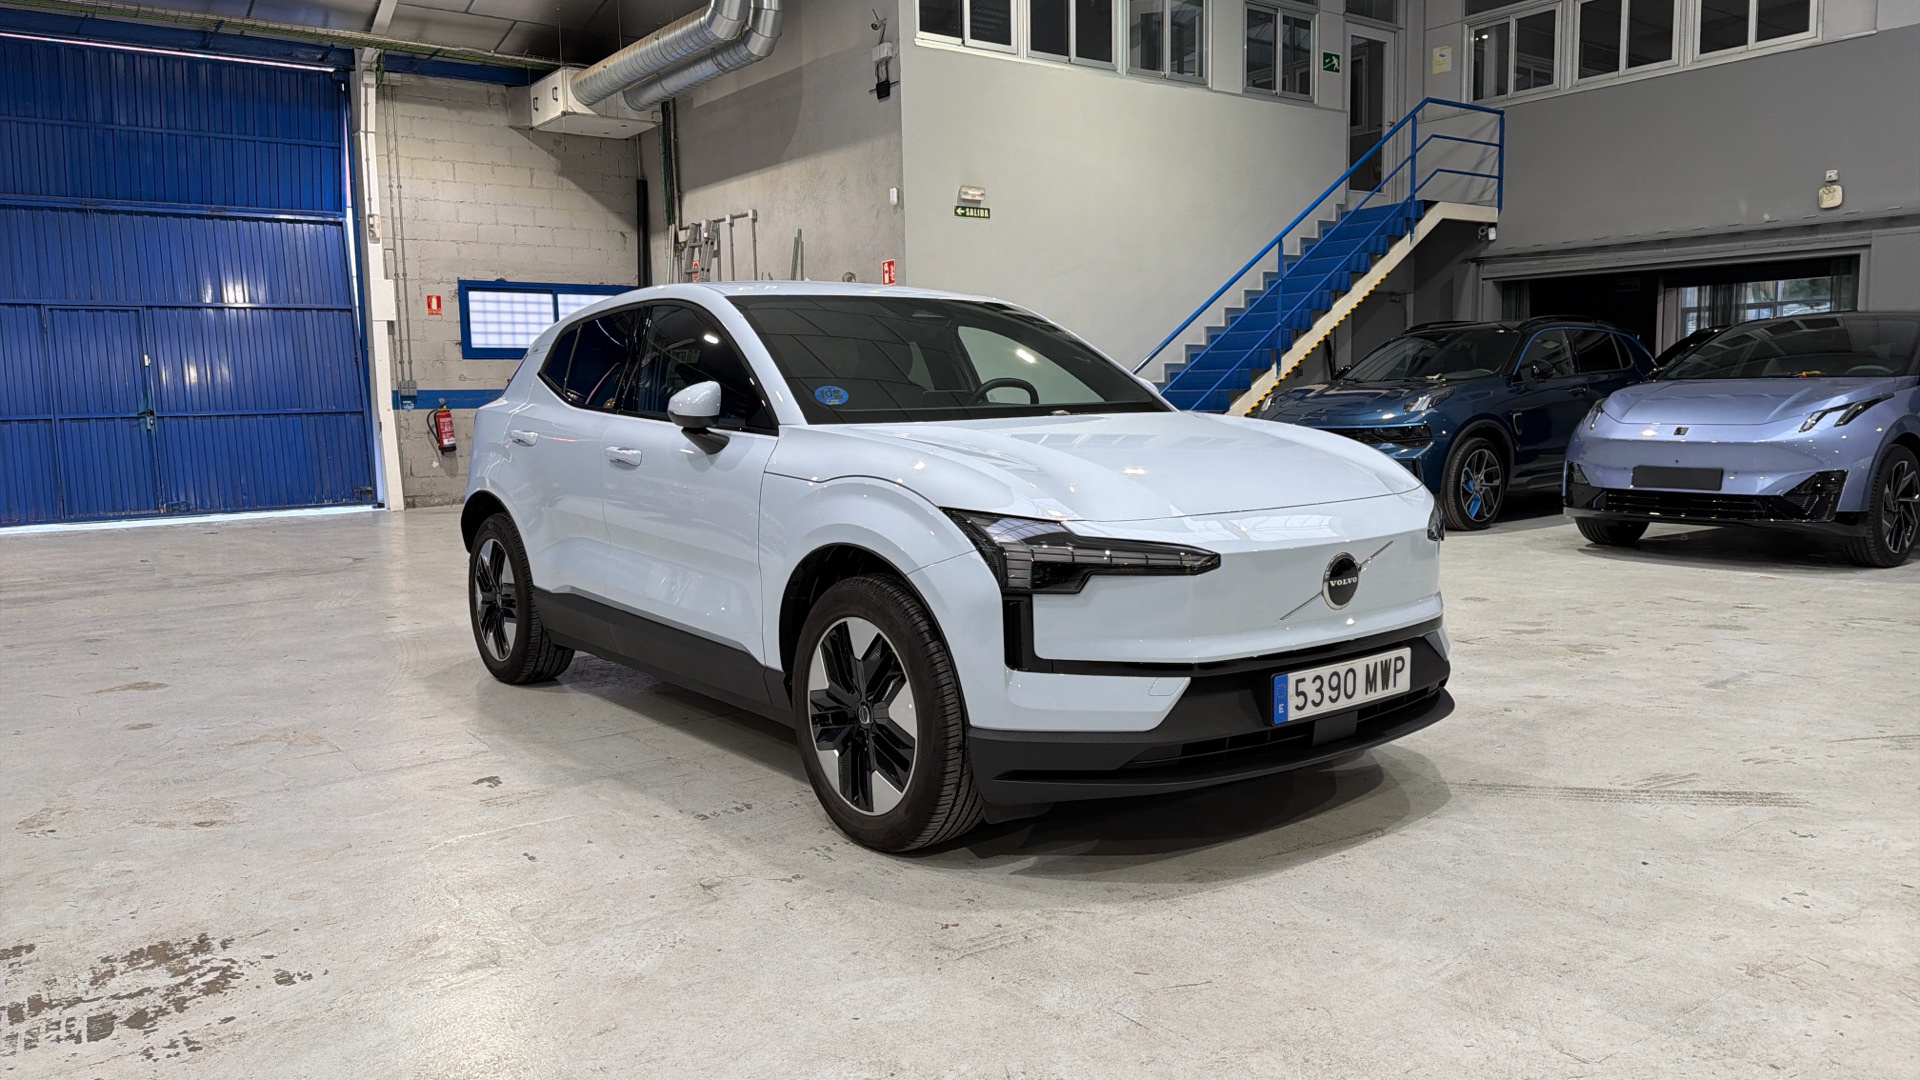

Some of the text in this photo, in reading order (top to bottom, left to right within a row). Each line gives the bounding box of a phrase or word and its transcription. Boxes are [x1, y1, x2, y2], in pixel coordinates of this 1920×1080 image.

[965, 208, 989, 217] SALIDA
[1330, 576, 1358, 587] VOLVO
[1294, 655, 1406, 711] 5390 MWP
[1278, 703, 1285, 714] E
